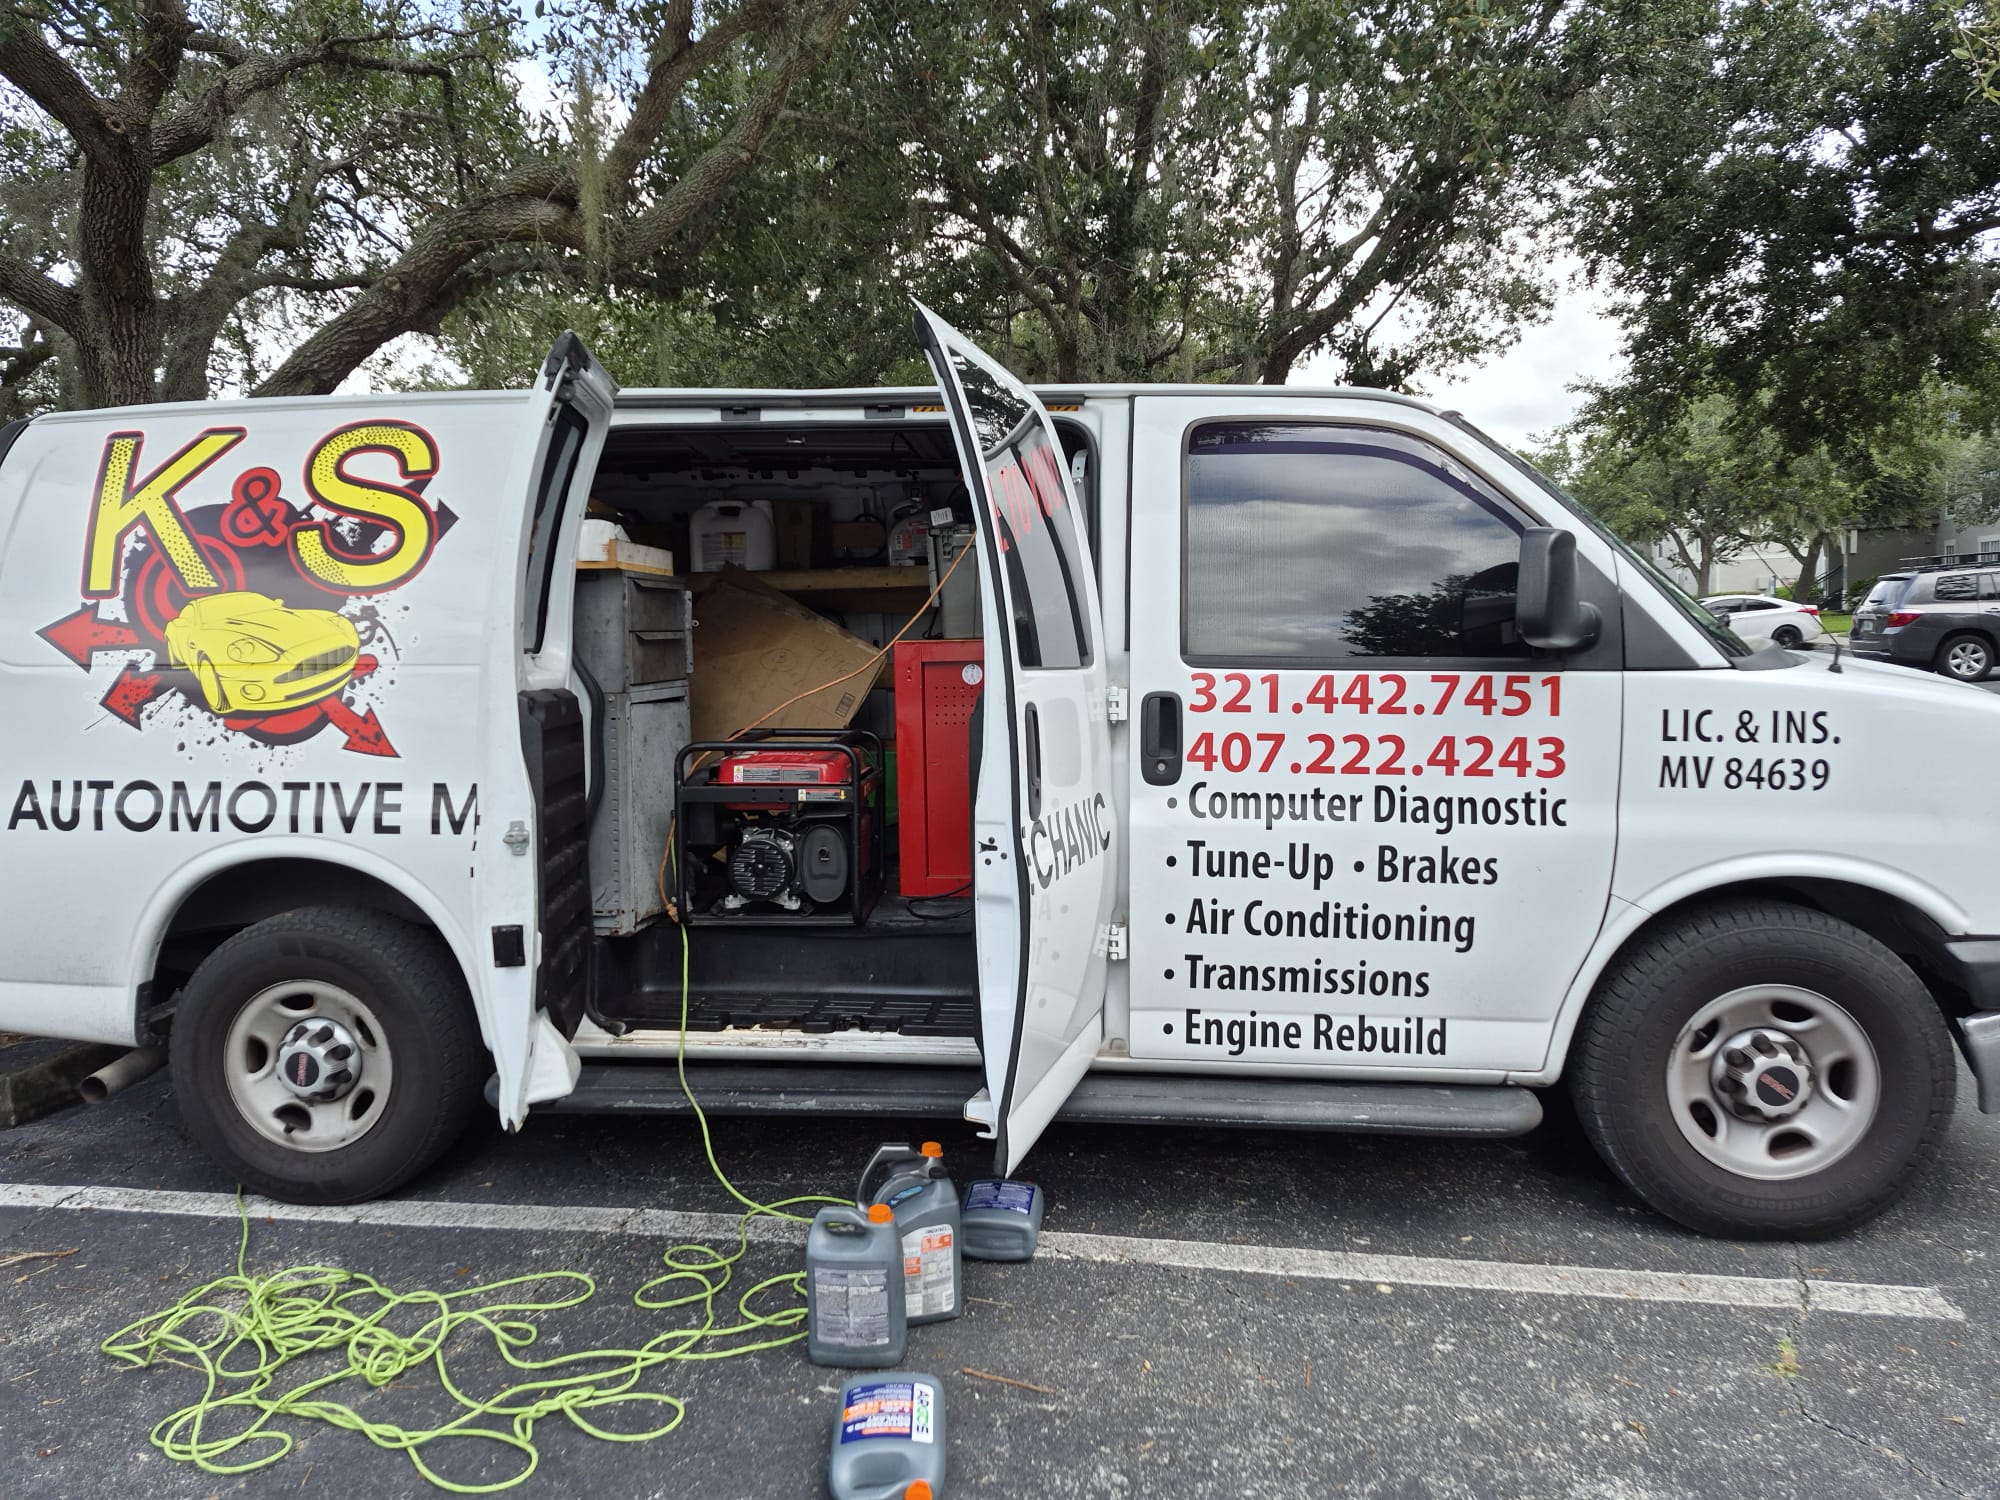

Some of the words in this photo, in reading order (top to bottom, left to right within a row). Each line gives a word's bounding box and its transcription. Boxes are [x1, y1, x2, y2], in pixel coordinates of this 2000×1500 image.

[1189, 673, 1561, 717] 321.442.7451
[1662, 709, 1724, 743] LIC.
[1736, 709, 1759, 743] &
[1772, 710, 1841, 745] INS.
[1186, 732, 1566, 778] 407.222.4243
[1659, 755, 1714, 789] MV
[1725, 757, 1830, 791] 84639
[8, 780, 403, 835] AUTOMOTIVE
[1188, 782, 1363, 830] Computer
[1374, 785, 1567, 835] Diagnostic
[1186, 840, 1334, 891] Tune-Up
[1377, 845, 1498, 886] Brakes
[1185, 899, 1235, 935] Air
[1243, 900, 1475, 954] Conditioning
[1184, 955, 1430, 998] Transmissions
[1185, 1009, 1302, 1056] Engine
[1313, 1013, 1447, 1056] Rebuild
